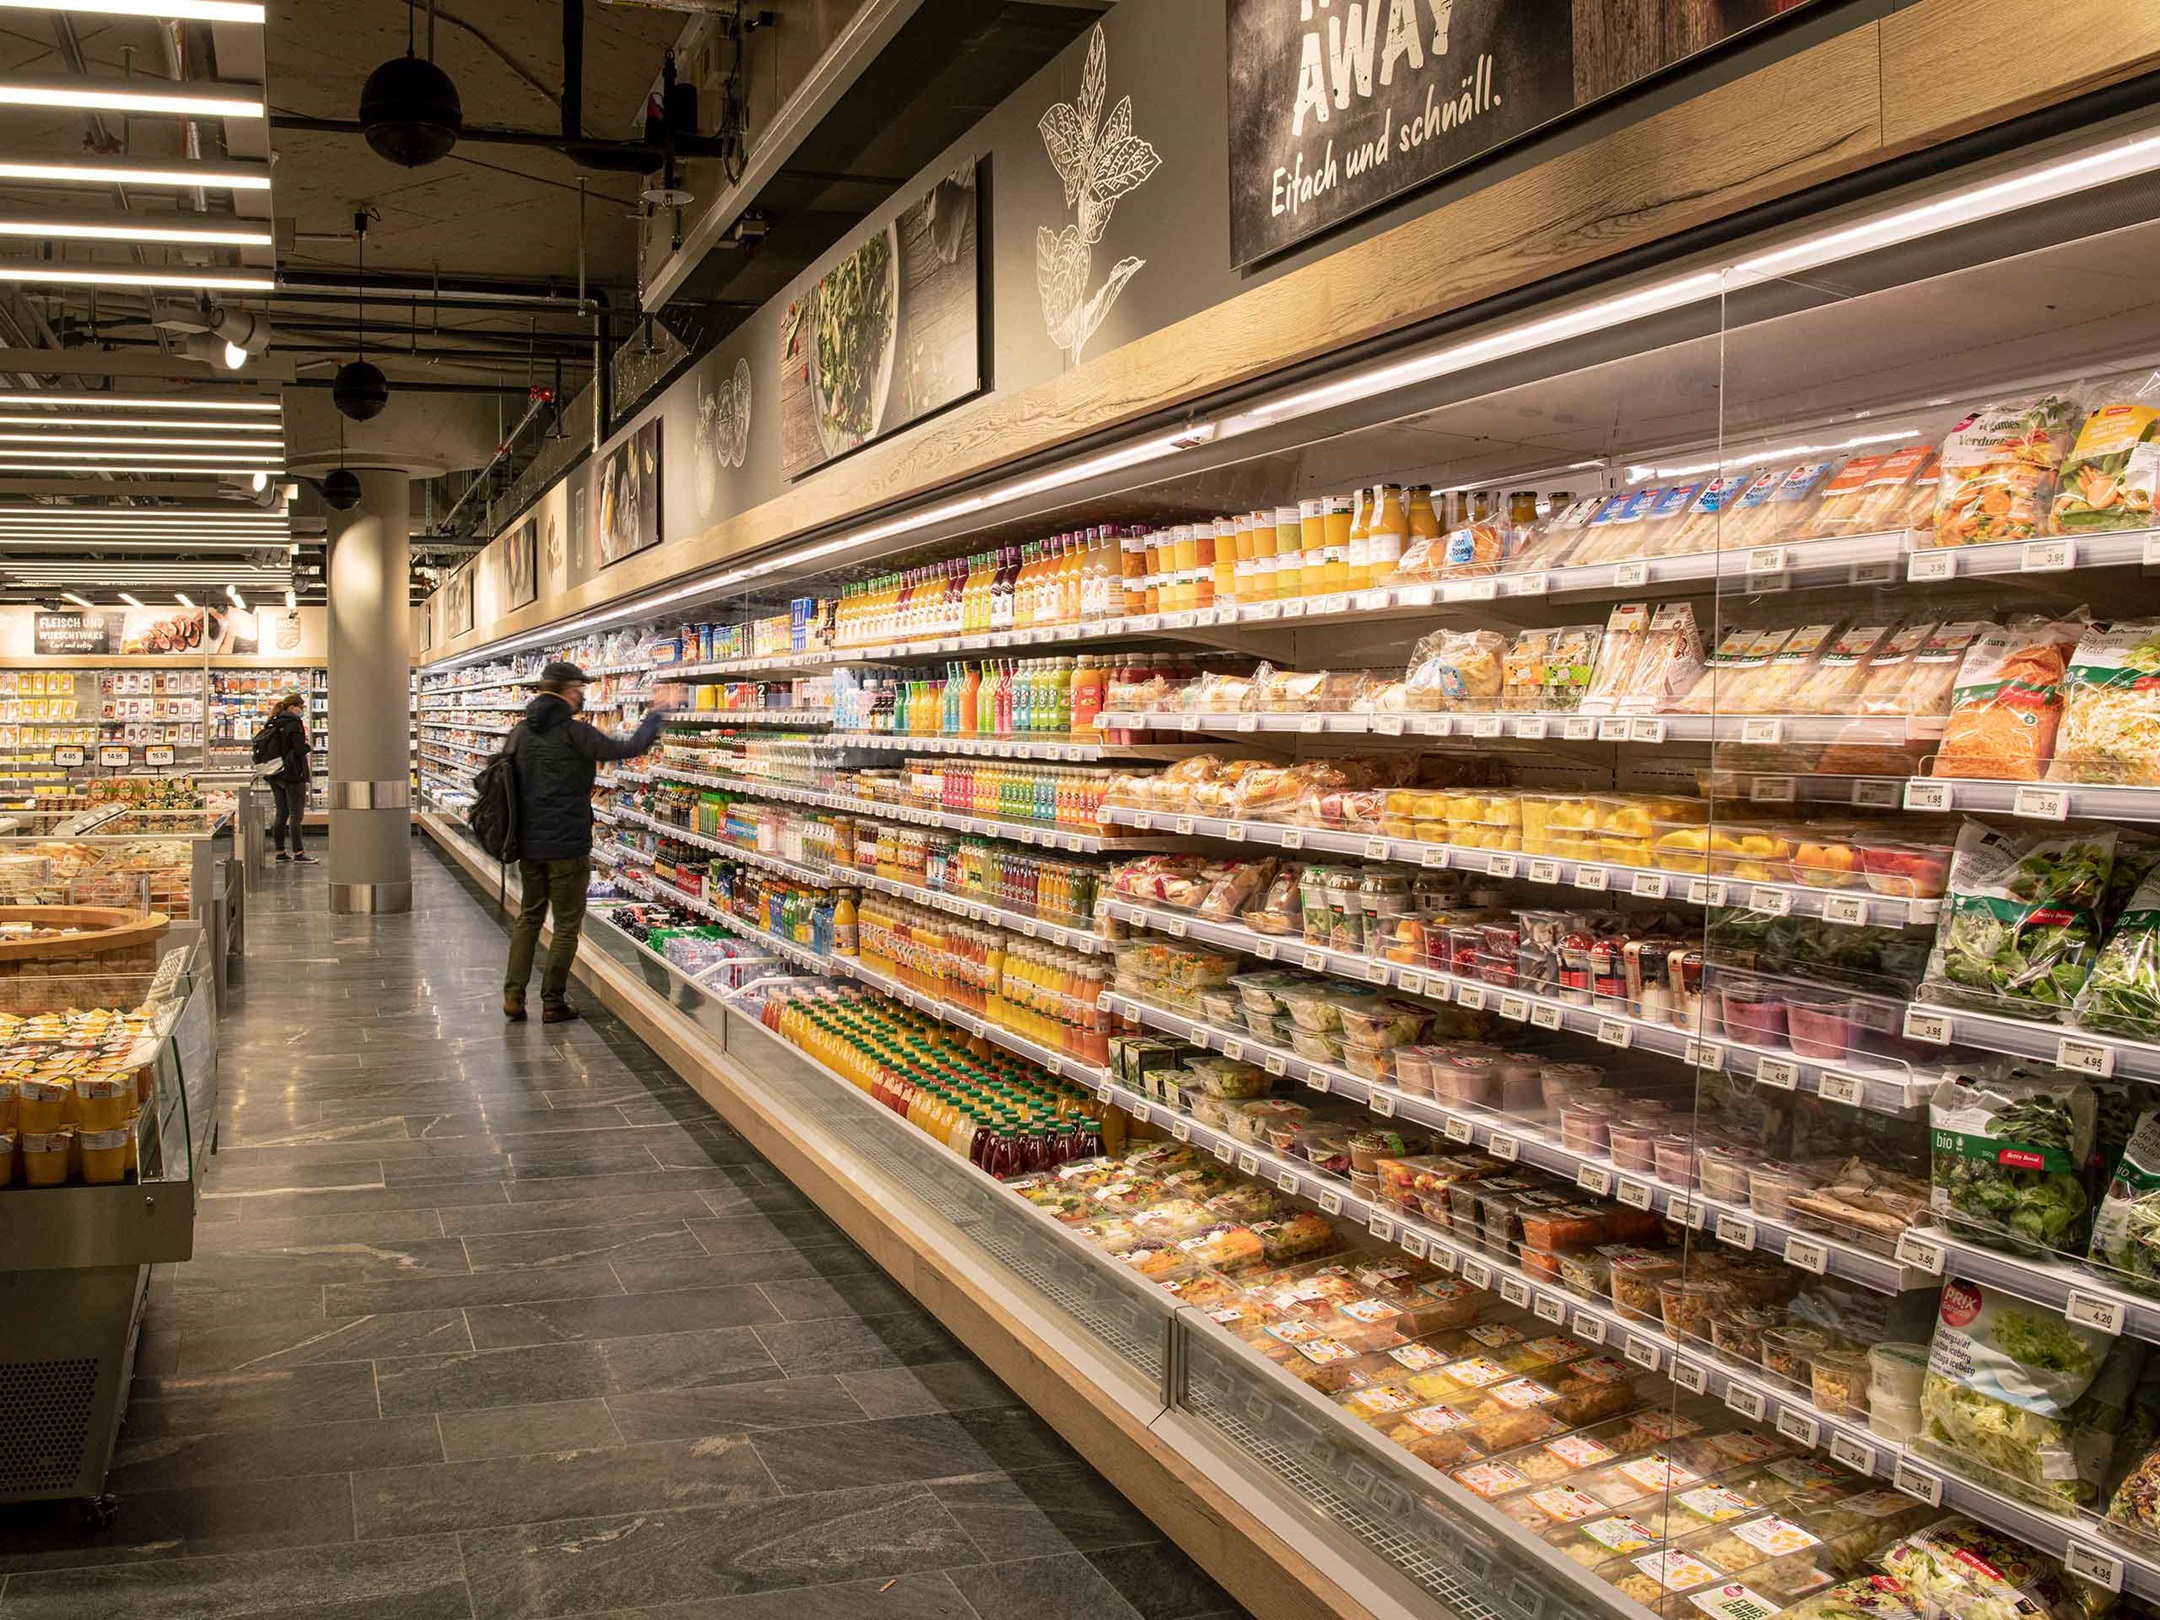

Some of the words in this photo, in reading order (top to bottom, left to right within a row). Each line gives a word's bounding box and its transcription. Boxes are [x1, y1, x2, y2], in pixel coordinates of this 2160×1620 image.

[1291, 0, 1453, 137] AWAY
[1271, 139, 1338, 218] Eifach
[1345, 107, 1392, 180] und
[1398, 53, 1502, 153] schnäll.
[2047, 552, 2065, 563] 3.95
[39, 617, 80, 629] FLEISCH
[82, 617, 105, 629] UND
[1926, 794, 1942, 804] 1.95
[2039, 801, 2058, 812] 3.50
[1925, 1025, 1943, 1036] 3.95
[2083, 1056, 2103, 1067] 4.95
[1936, 1131, 1953, 1150] bio
[2006, 1151, 2023, 1162] Betty
[1917, 1252, 1935, 1266] 3.50
[1944, 1286, 1978, 1311] PRIX
[2093, 1311, 2113, 1325] 4.20
[1949, 1344, 1973, 1365] iceberg
[1950, 1357, 1976, 1378] iceberg
[1849, 1452, 1865, 1466] 2.40
[1915, 1481, 1932, 1496] 3.50
[2091, 1565, 2112, 1580] 4.35
[1733, 1598, 1768, 1619] COUS
